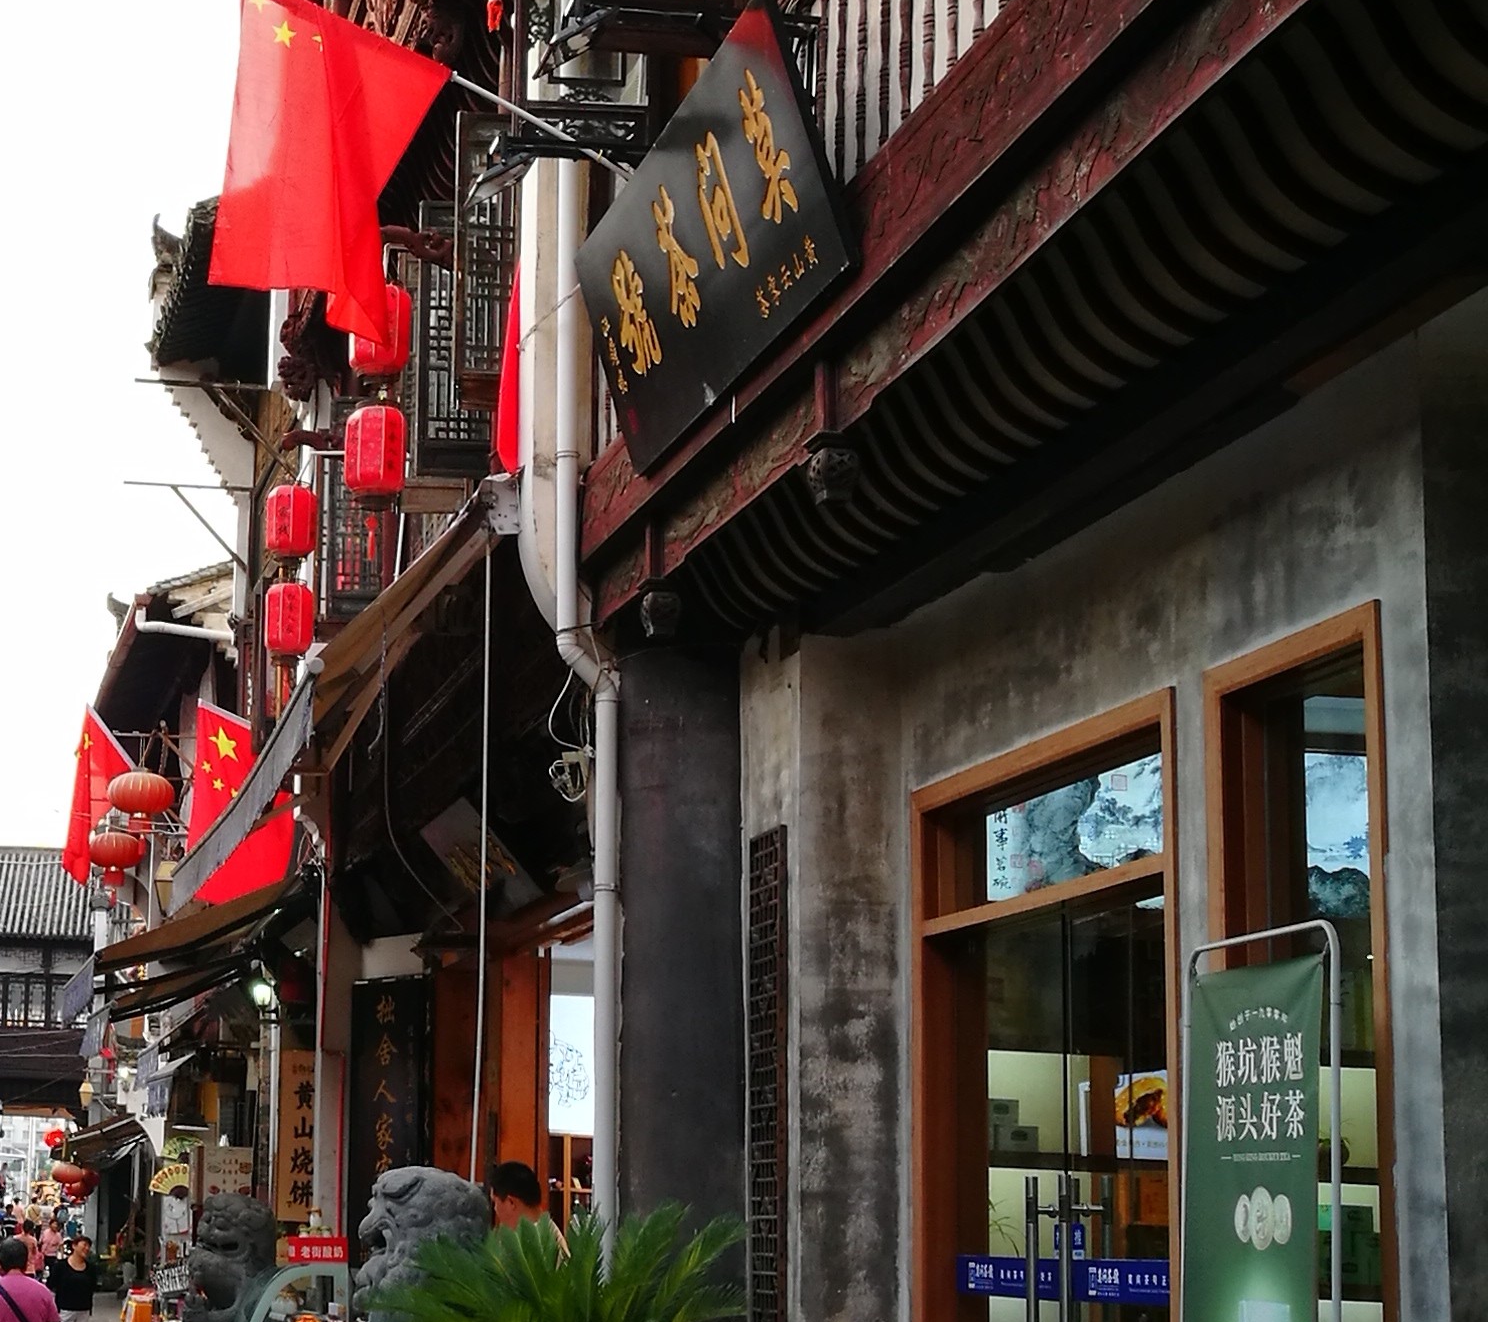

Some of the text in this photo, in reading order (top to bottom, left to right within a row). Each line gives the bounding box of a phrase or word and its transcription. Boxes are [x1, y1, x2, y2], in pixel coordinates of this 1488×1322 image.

[1215, 1031, 1305, 1088] 猴坑猴魁
[289, 1079, 316, 1208] 黄山烧饼
[1215, 1088, 1305, 1143] 源头好茶
